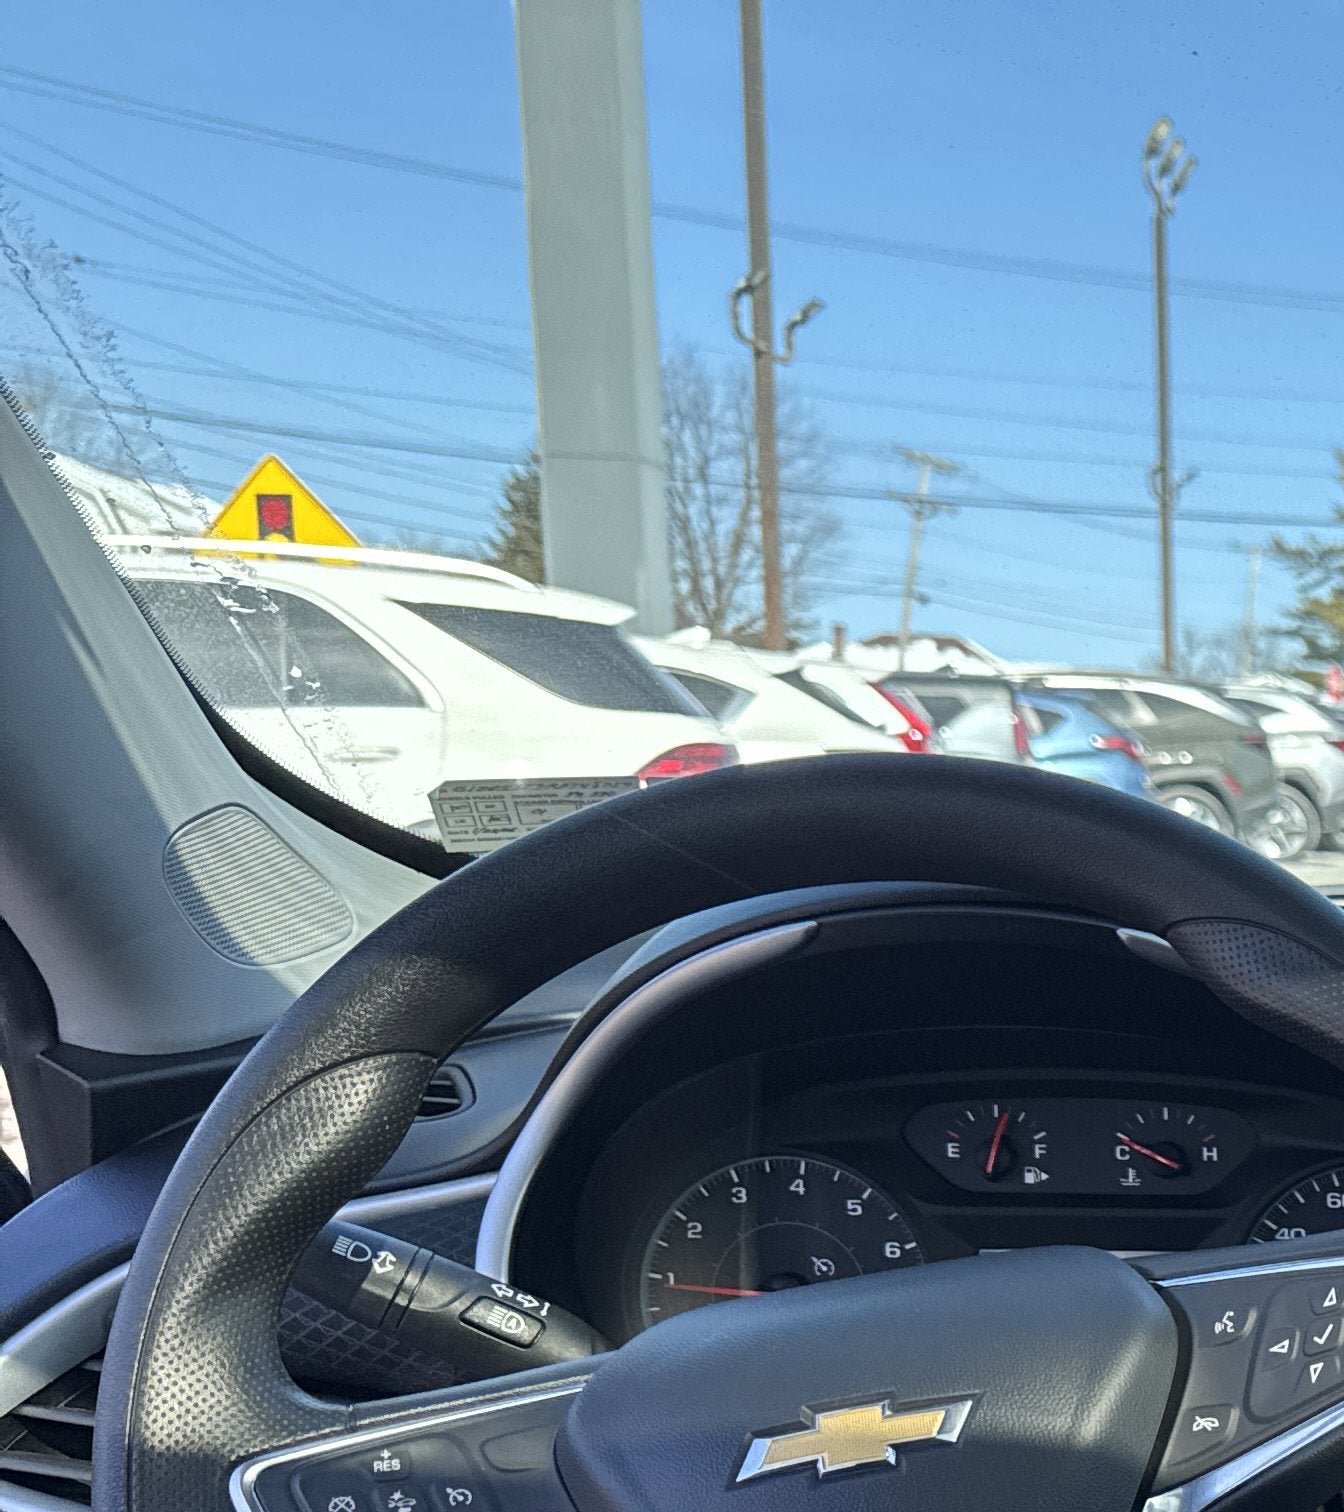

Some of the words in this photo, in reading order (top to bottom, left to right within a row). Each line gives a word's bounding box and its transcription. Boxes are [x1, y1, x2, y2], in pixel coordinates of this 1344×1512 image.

[947, 1143, 961, 1159] E
[1034, 1144, 1048, 1159] F
[1115, 1146, 1130, 1161] C
[1202, 1147, 1218, 1162] H
[731, 1186, 748, 1204] 3
[789, 1178, 806, 1196] 4
[847, 1199, 863, 1216] 5
[687, 1222, 703, 1239] 2
[884, 1241, 901, 1259] 6
[667, 1272, 675, 1286] 1
[373, 1458, 401, 1473] RES
